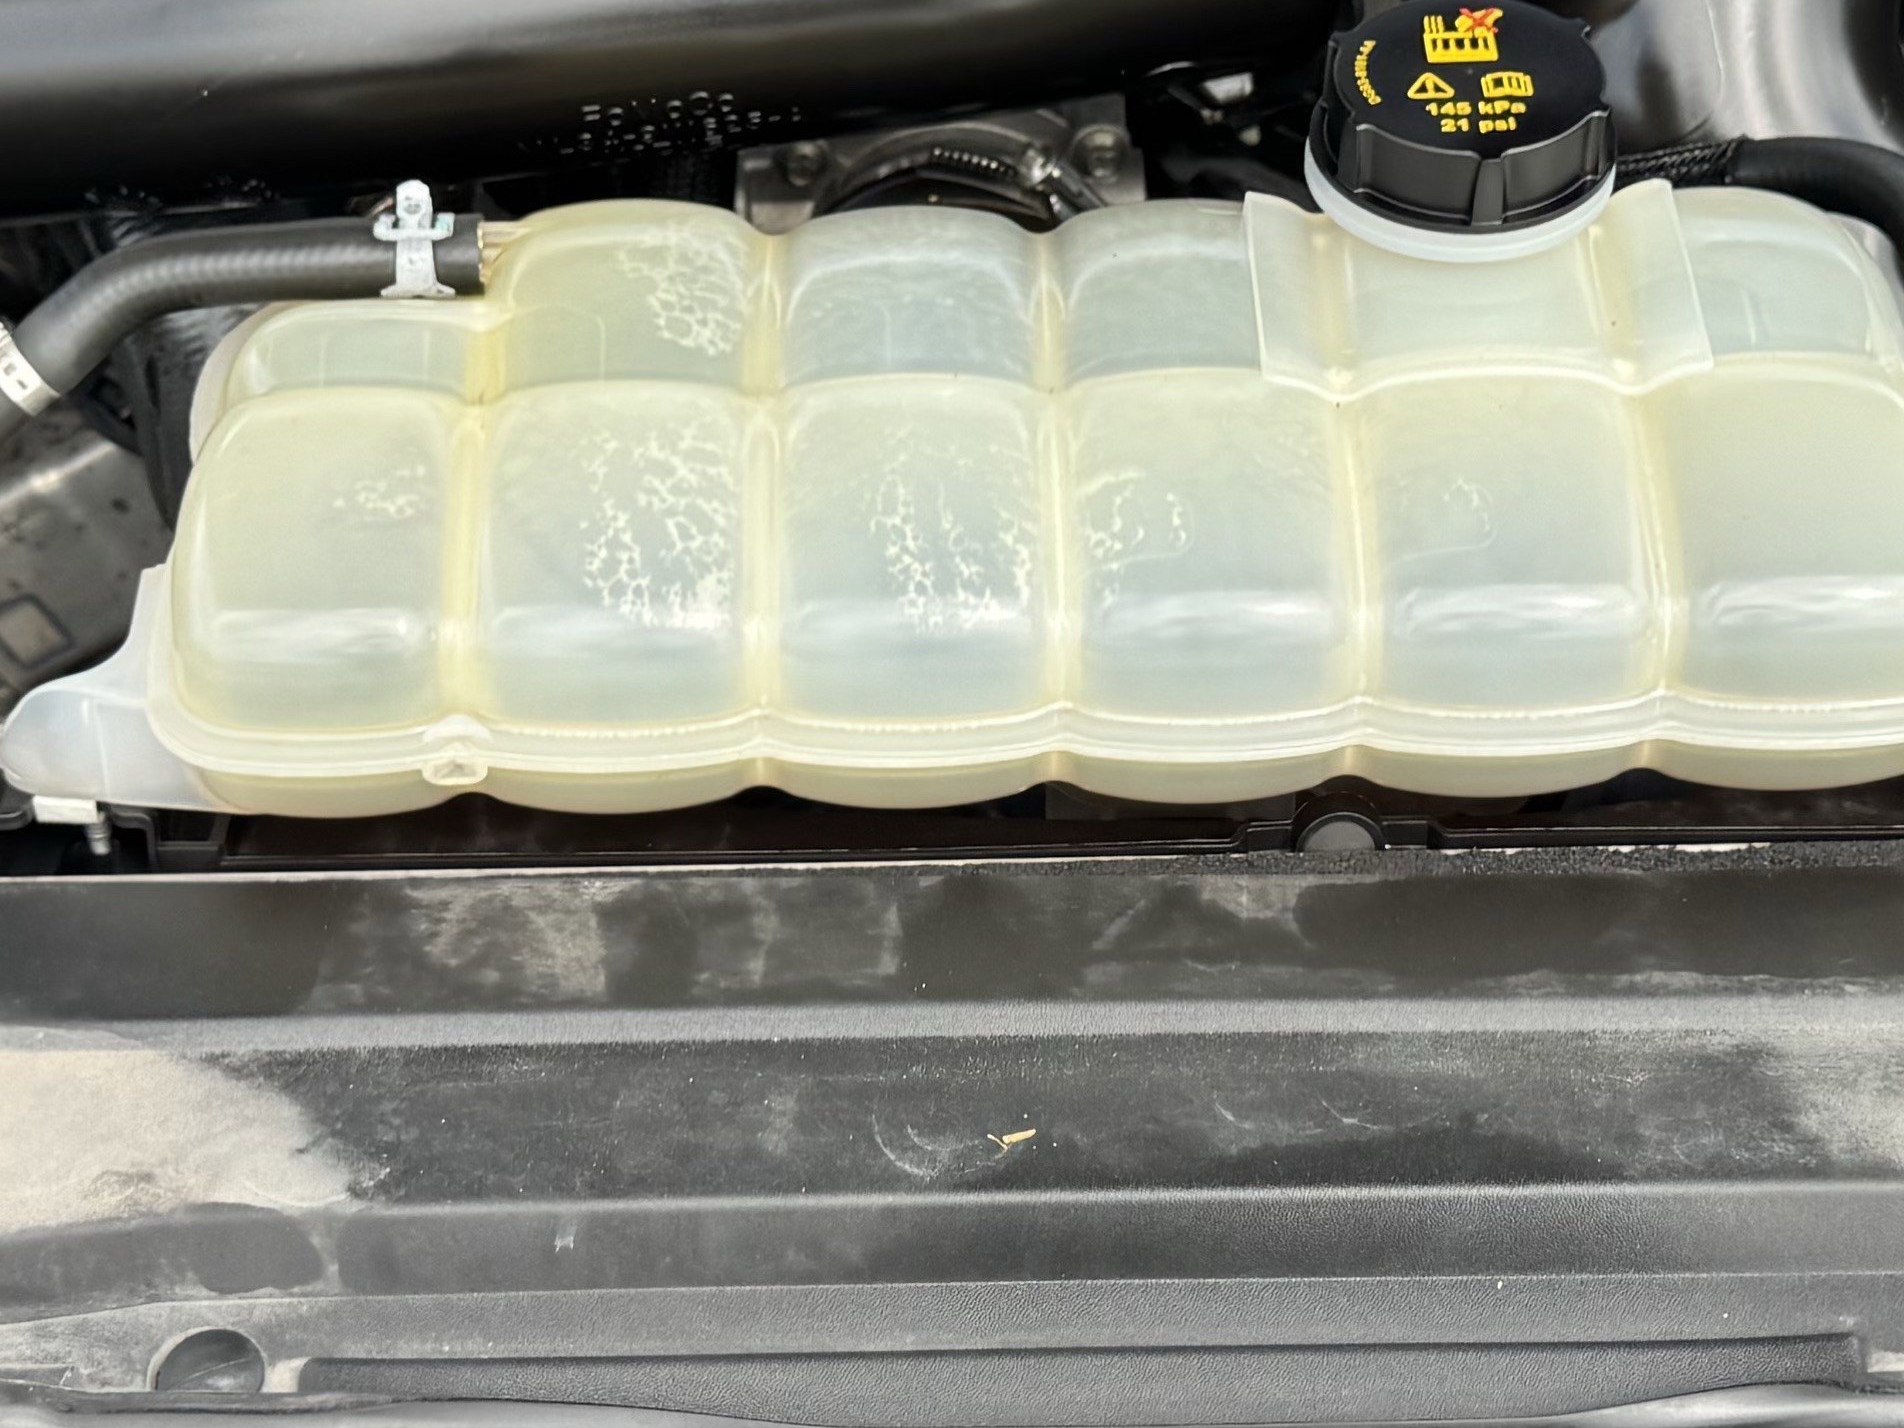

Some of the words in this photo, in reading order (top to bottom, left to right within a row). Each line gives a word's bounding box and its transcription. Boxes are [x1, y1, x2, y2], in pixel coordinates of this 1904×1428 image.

[1425, 101, 1472, 117] 145
[1478, 100, 1526, 116] kPa
[1440, 118, 1470, 133] 21
[1478, 116, 1517, 134] psi
